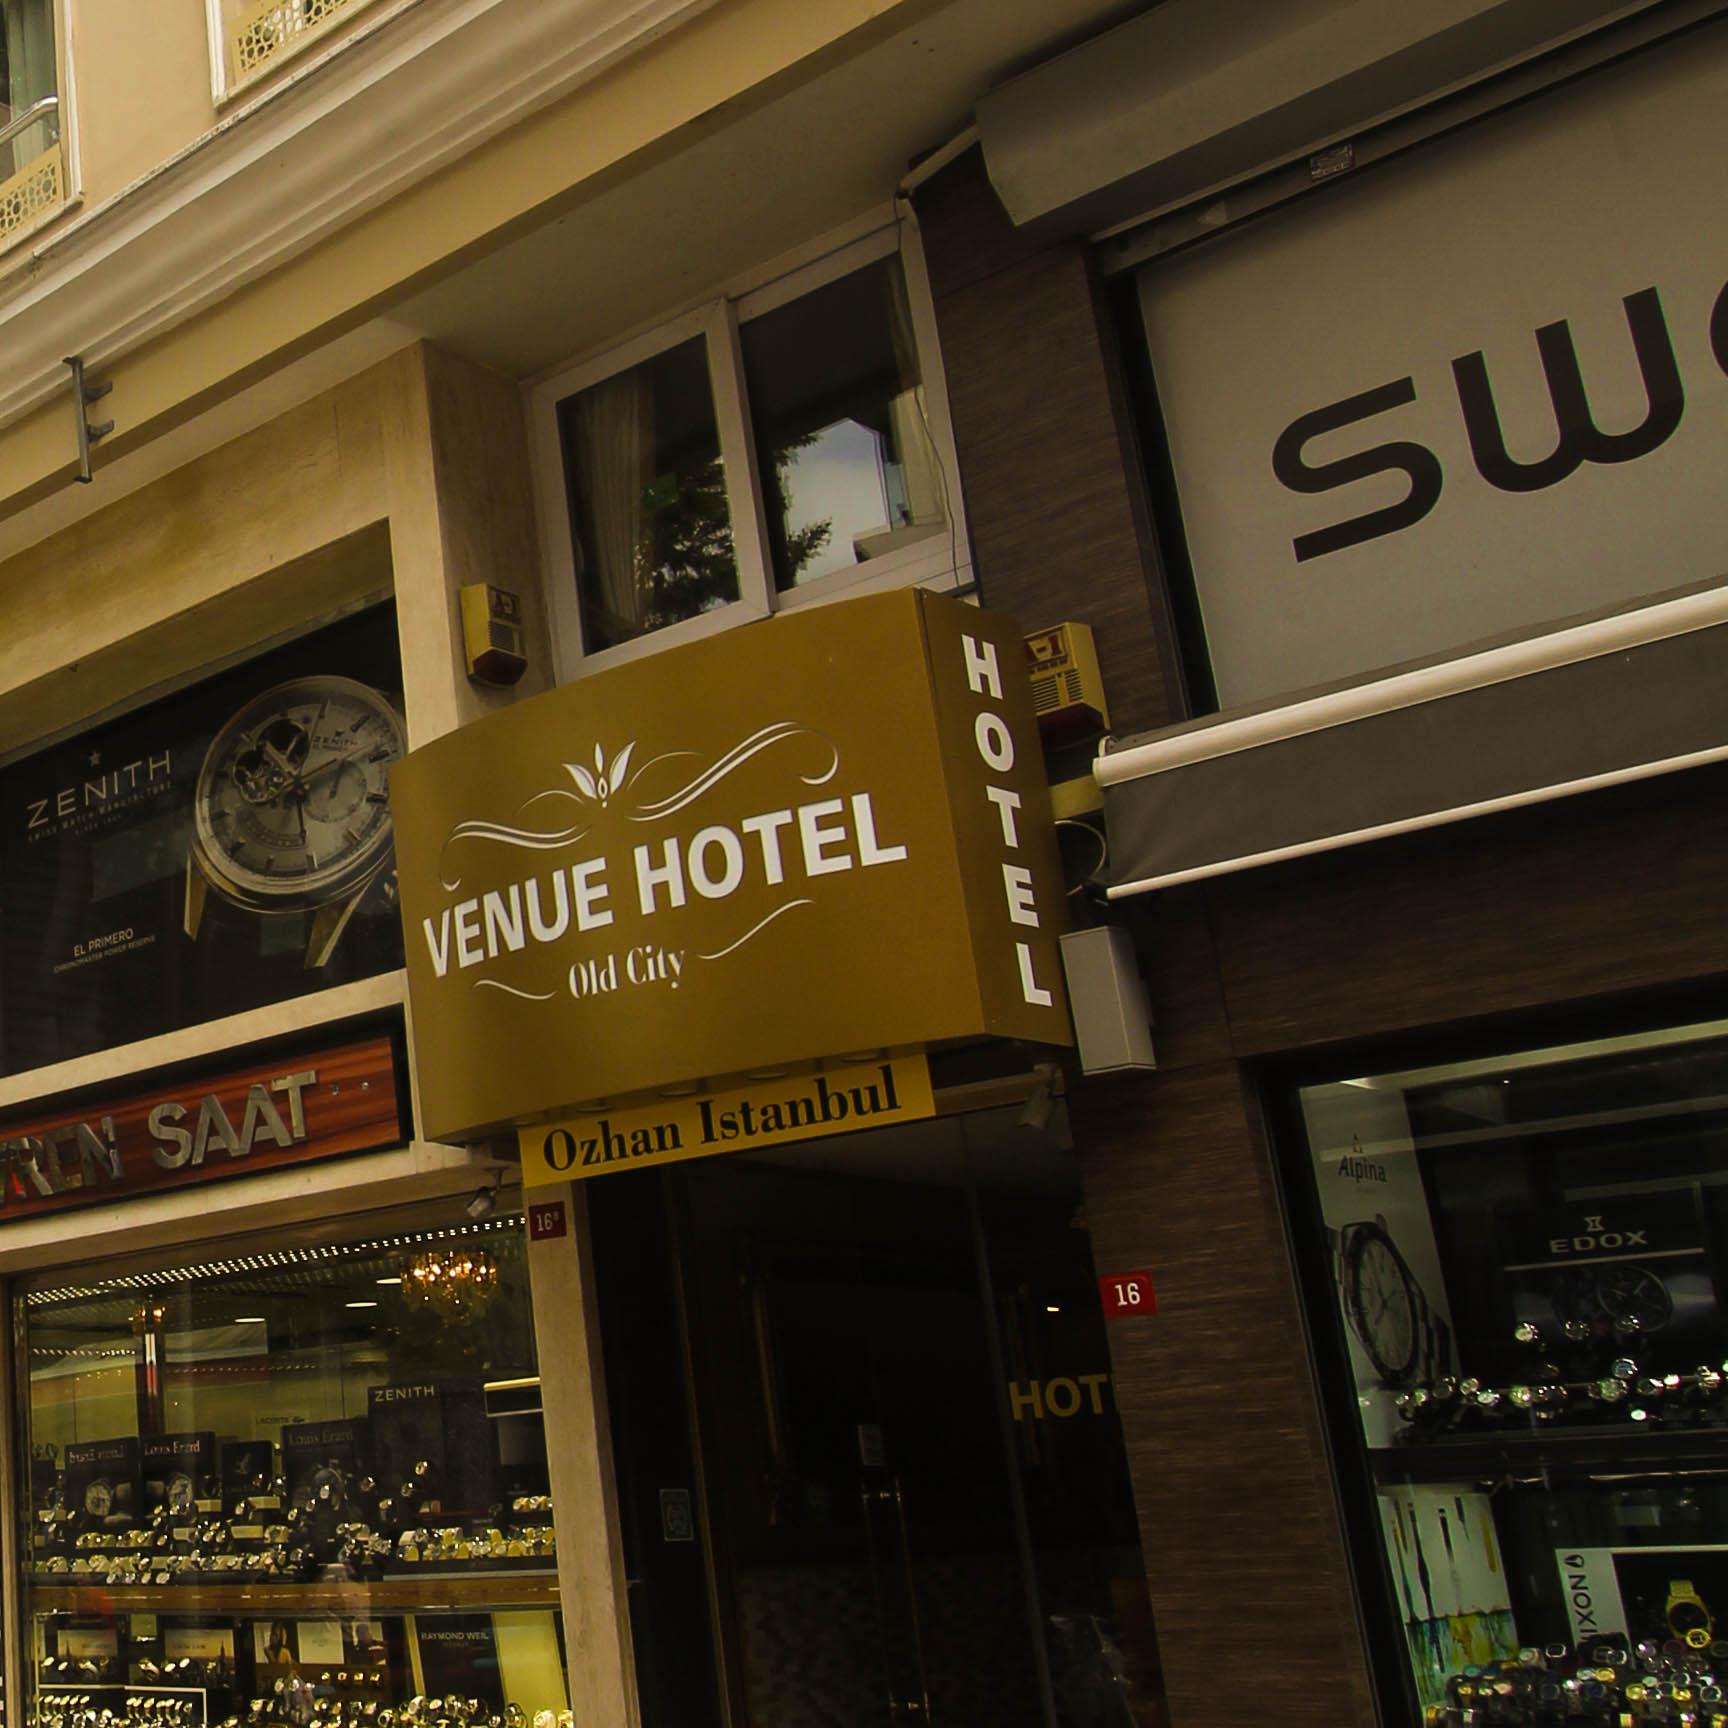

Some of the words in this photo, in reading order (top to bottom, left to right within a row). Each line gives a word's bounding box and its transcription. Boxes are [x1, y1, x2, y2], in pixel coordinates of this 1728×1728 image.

[26, 748, 172, 829] ZENITH
[961, 632, 1053, 1008] HOTEL
[422, 856, 614, 978] VENUE
[633, 791, 909, 917] HOTEL
[73, 944, 87, 958] EL
[89, 927, 135, 953] PRIMERO
[568, 952, 618, 1001] Old
[626, 944, 685, 990] City
[147, 1069, 317, 1169] SAAT
[541, 1111, 684, 1172] Ozhan
[698, 1063, 903, 1147] Istanbul
[1337, 1154, 1388, 1184] Alpina
[1550, 1230, 1649, 1255] EDOX
[1113, 1282, 1141, 1307] 16
[374, 1383, 436, 1403] ZENITH
[1008, 1372, 1122, 1423] HOT
[420, 1631, 465, 1641] RAYMOND
